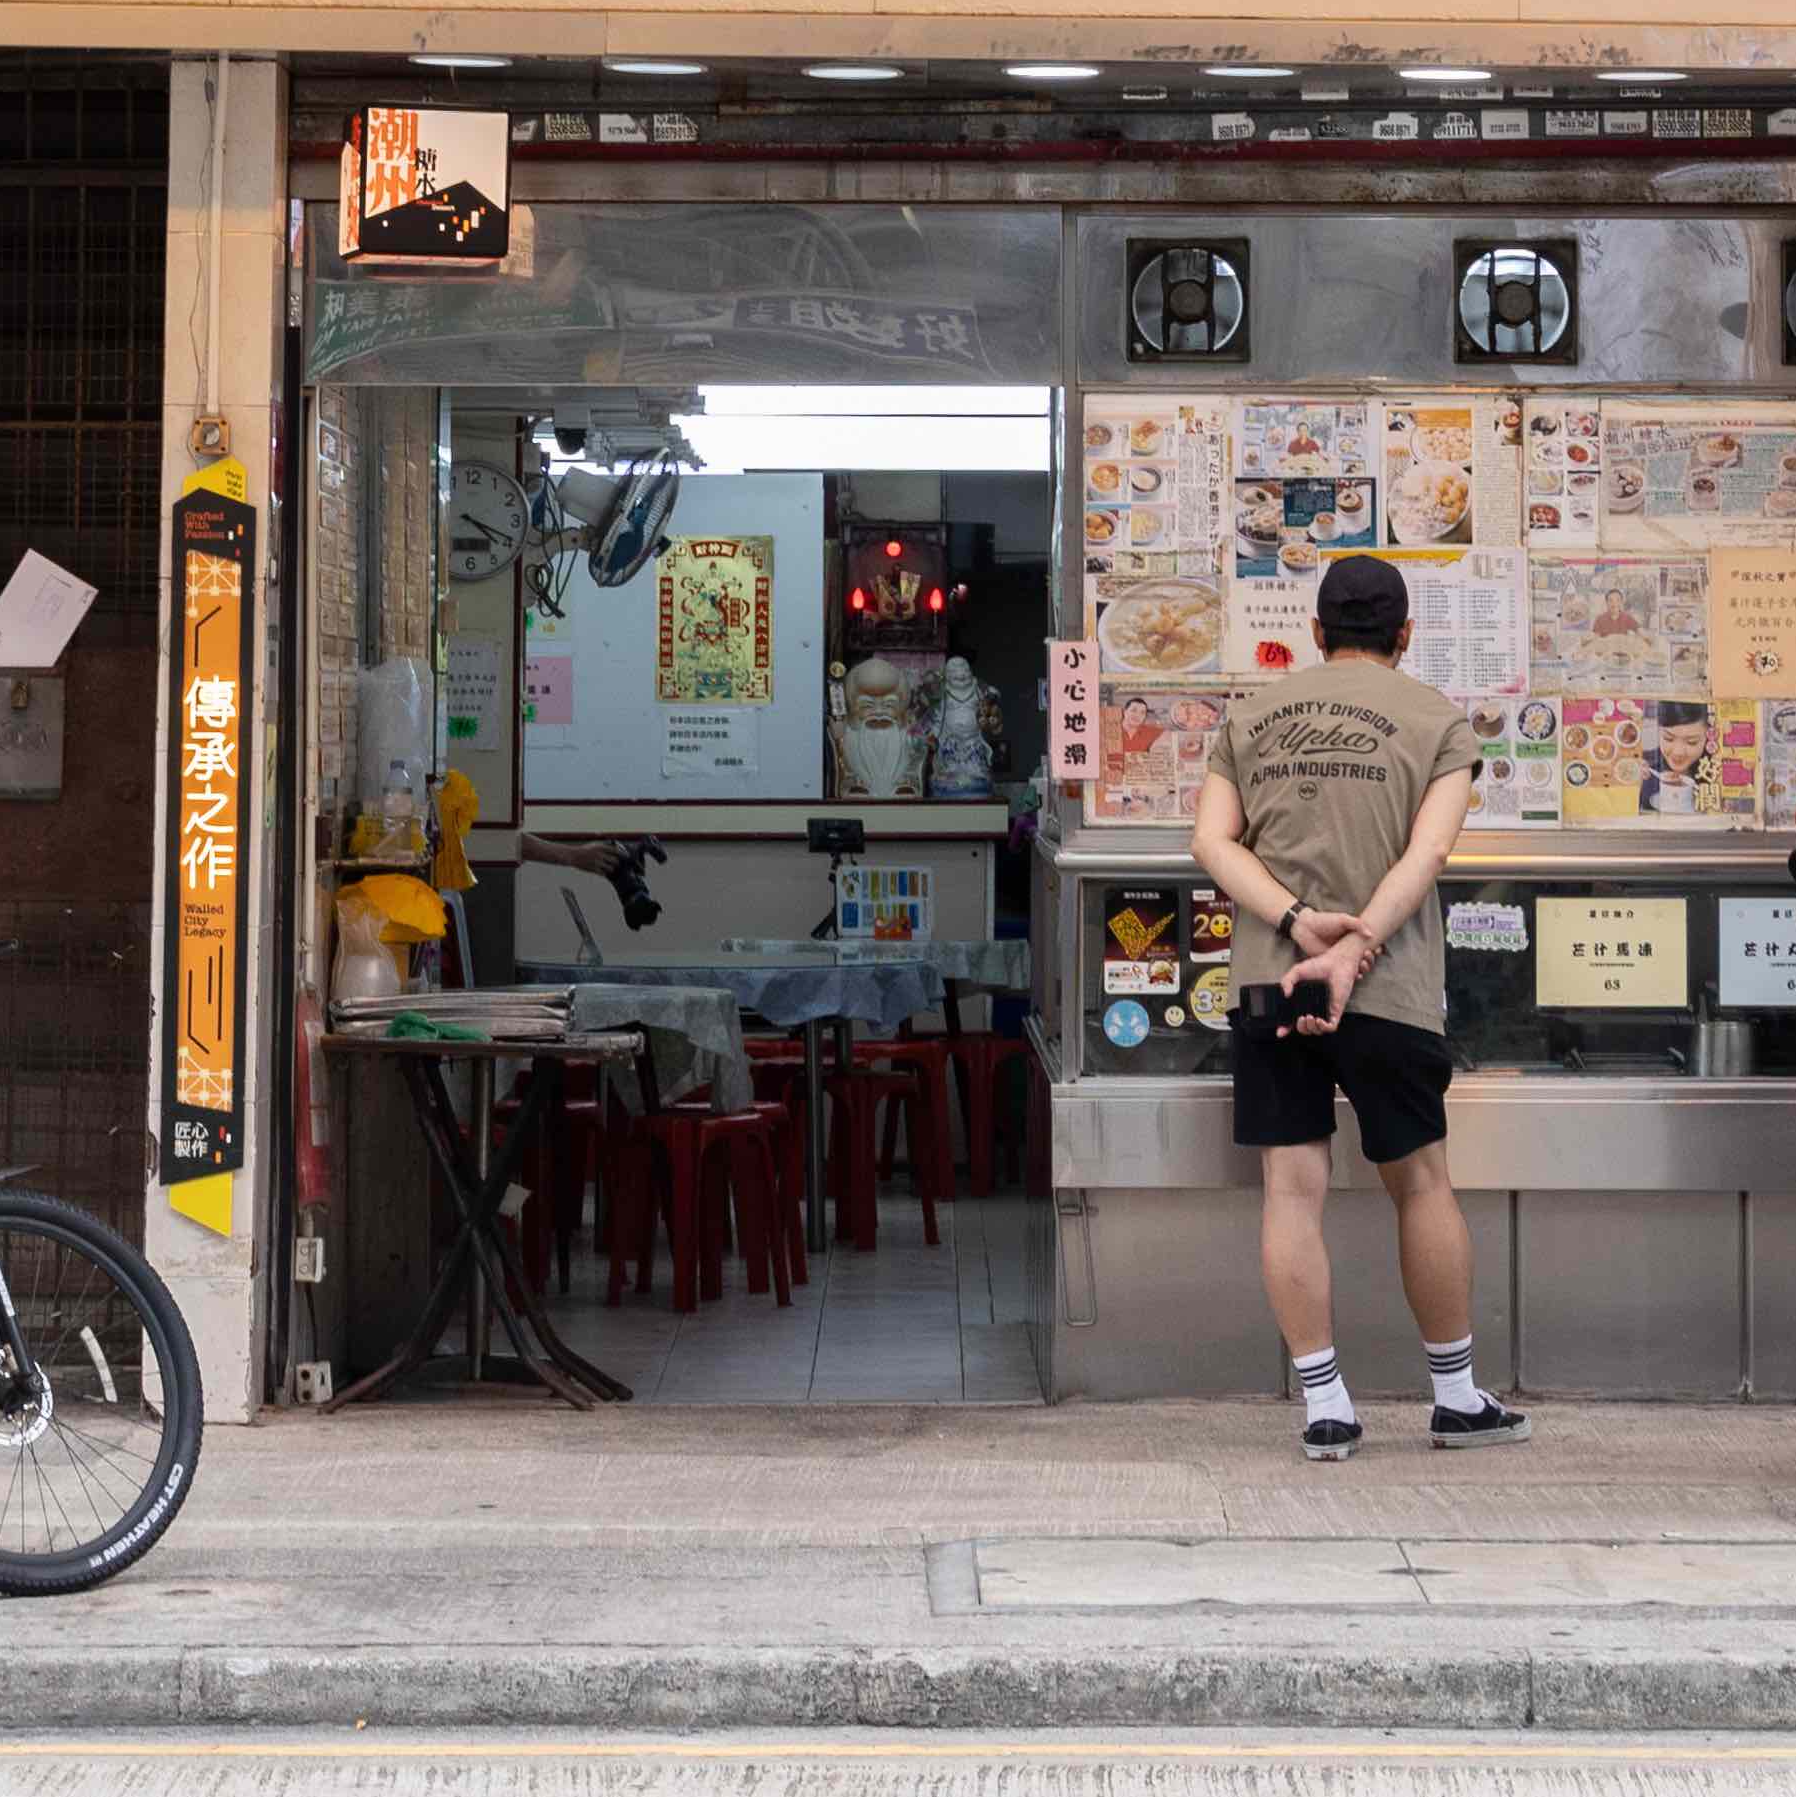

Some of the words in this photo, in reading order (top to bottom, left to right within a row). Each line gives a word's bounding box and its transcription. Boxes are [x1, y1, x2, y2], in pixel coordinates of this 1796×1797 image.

[465, 469, 482, 485] 12
[504, 493, 515, 507] 2
[510, 514, 521, 528] 3
[465, 557, 475, 570] 6
[1063, 648, 1087, 766] 小心地滑
[1329, 702, 1398, 738] DIVISION
[1258, 719, 1379, 757] Alpha
[1291, 760, 1388, 783] INDUSTRIES
[181, 675, 237, 890] 傳承之作
[184, 902, 224, 914] Walled
[184, 915, 209, 926] City
[184, 926, 227, 938] Legacy
[174, 1121, 209, 1139] 匠心
[173, 1140, 208, 1158] 製作
